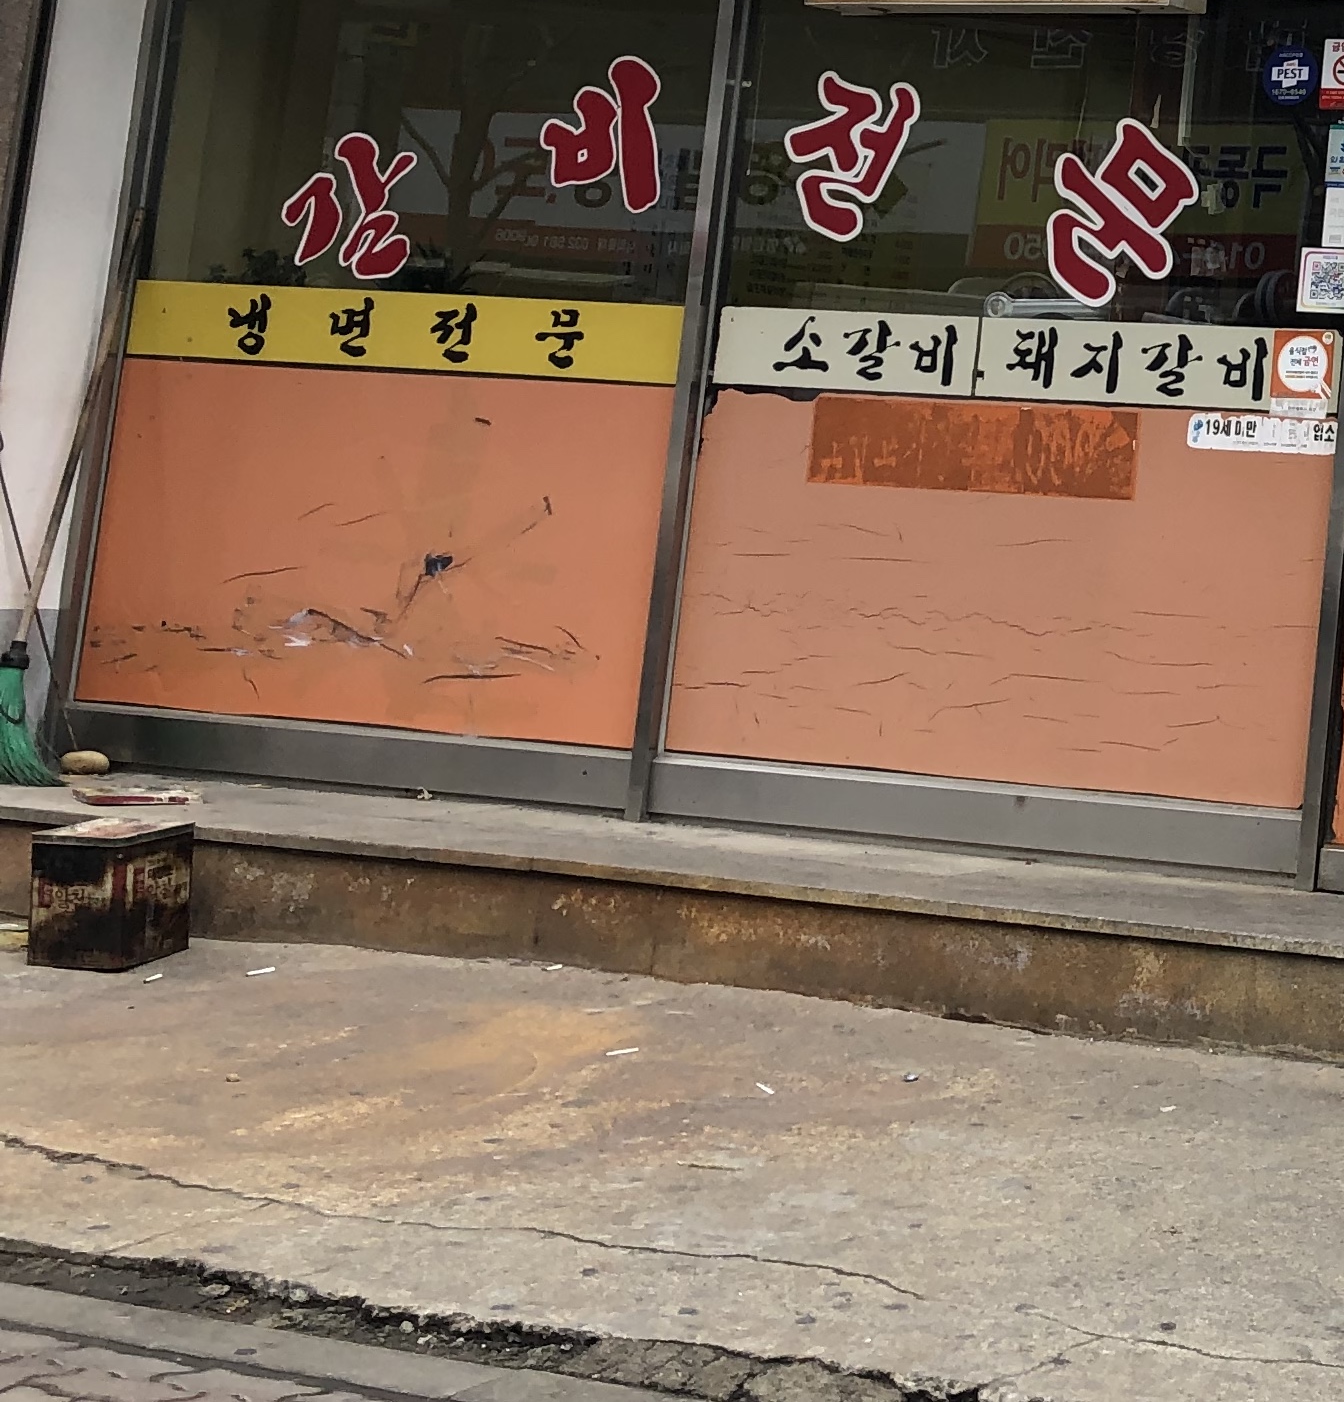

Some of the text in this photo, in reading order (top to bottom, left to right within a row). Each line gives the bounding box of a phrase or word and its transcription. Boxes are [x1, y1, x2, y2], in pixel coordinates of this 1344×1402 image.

[1276, 68, 1303, 80] PEST
[227, 293, 585, 369] 냉면전문
[772, 316, 1270, 401] 소갈비 돼지갈비
